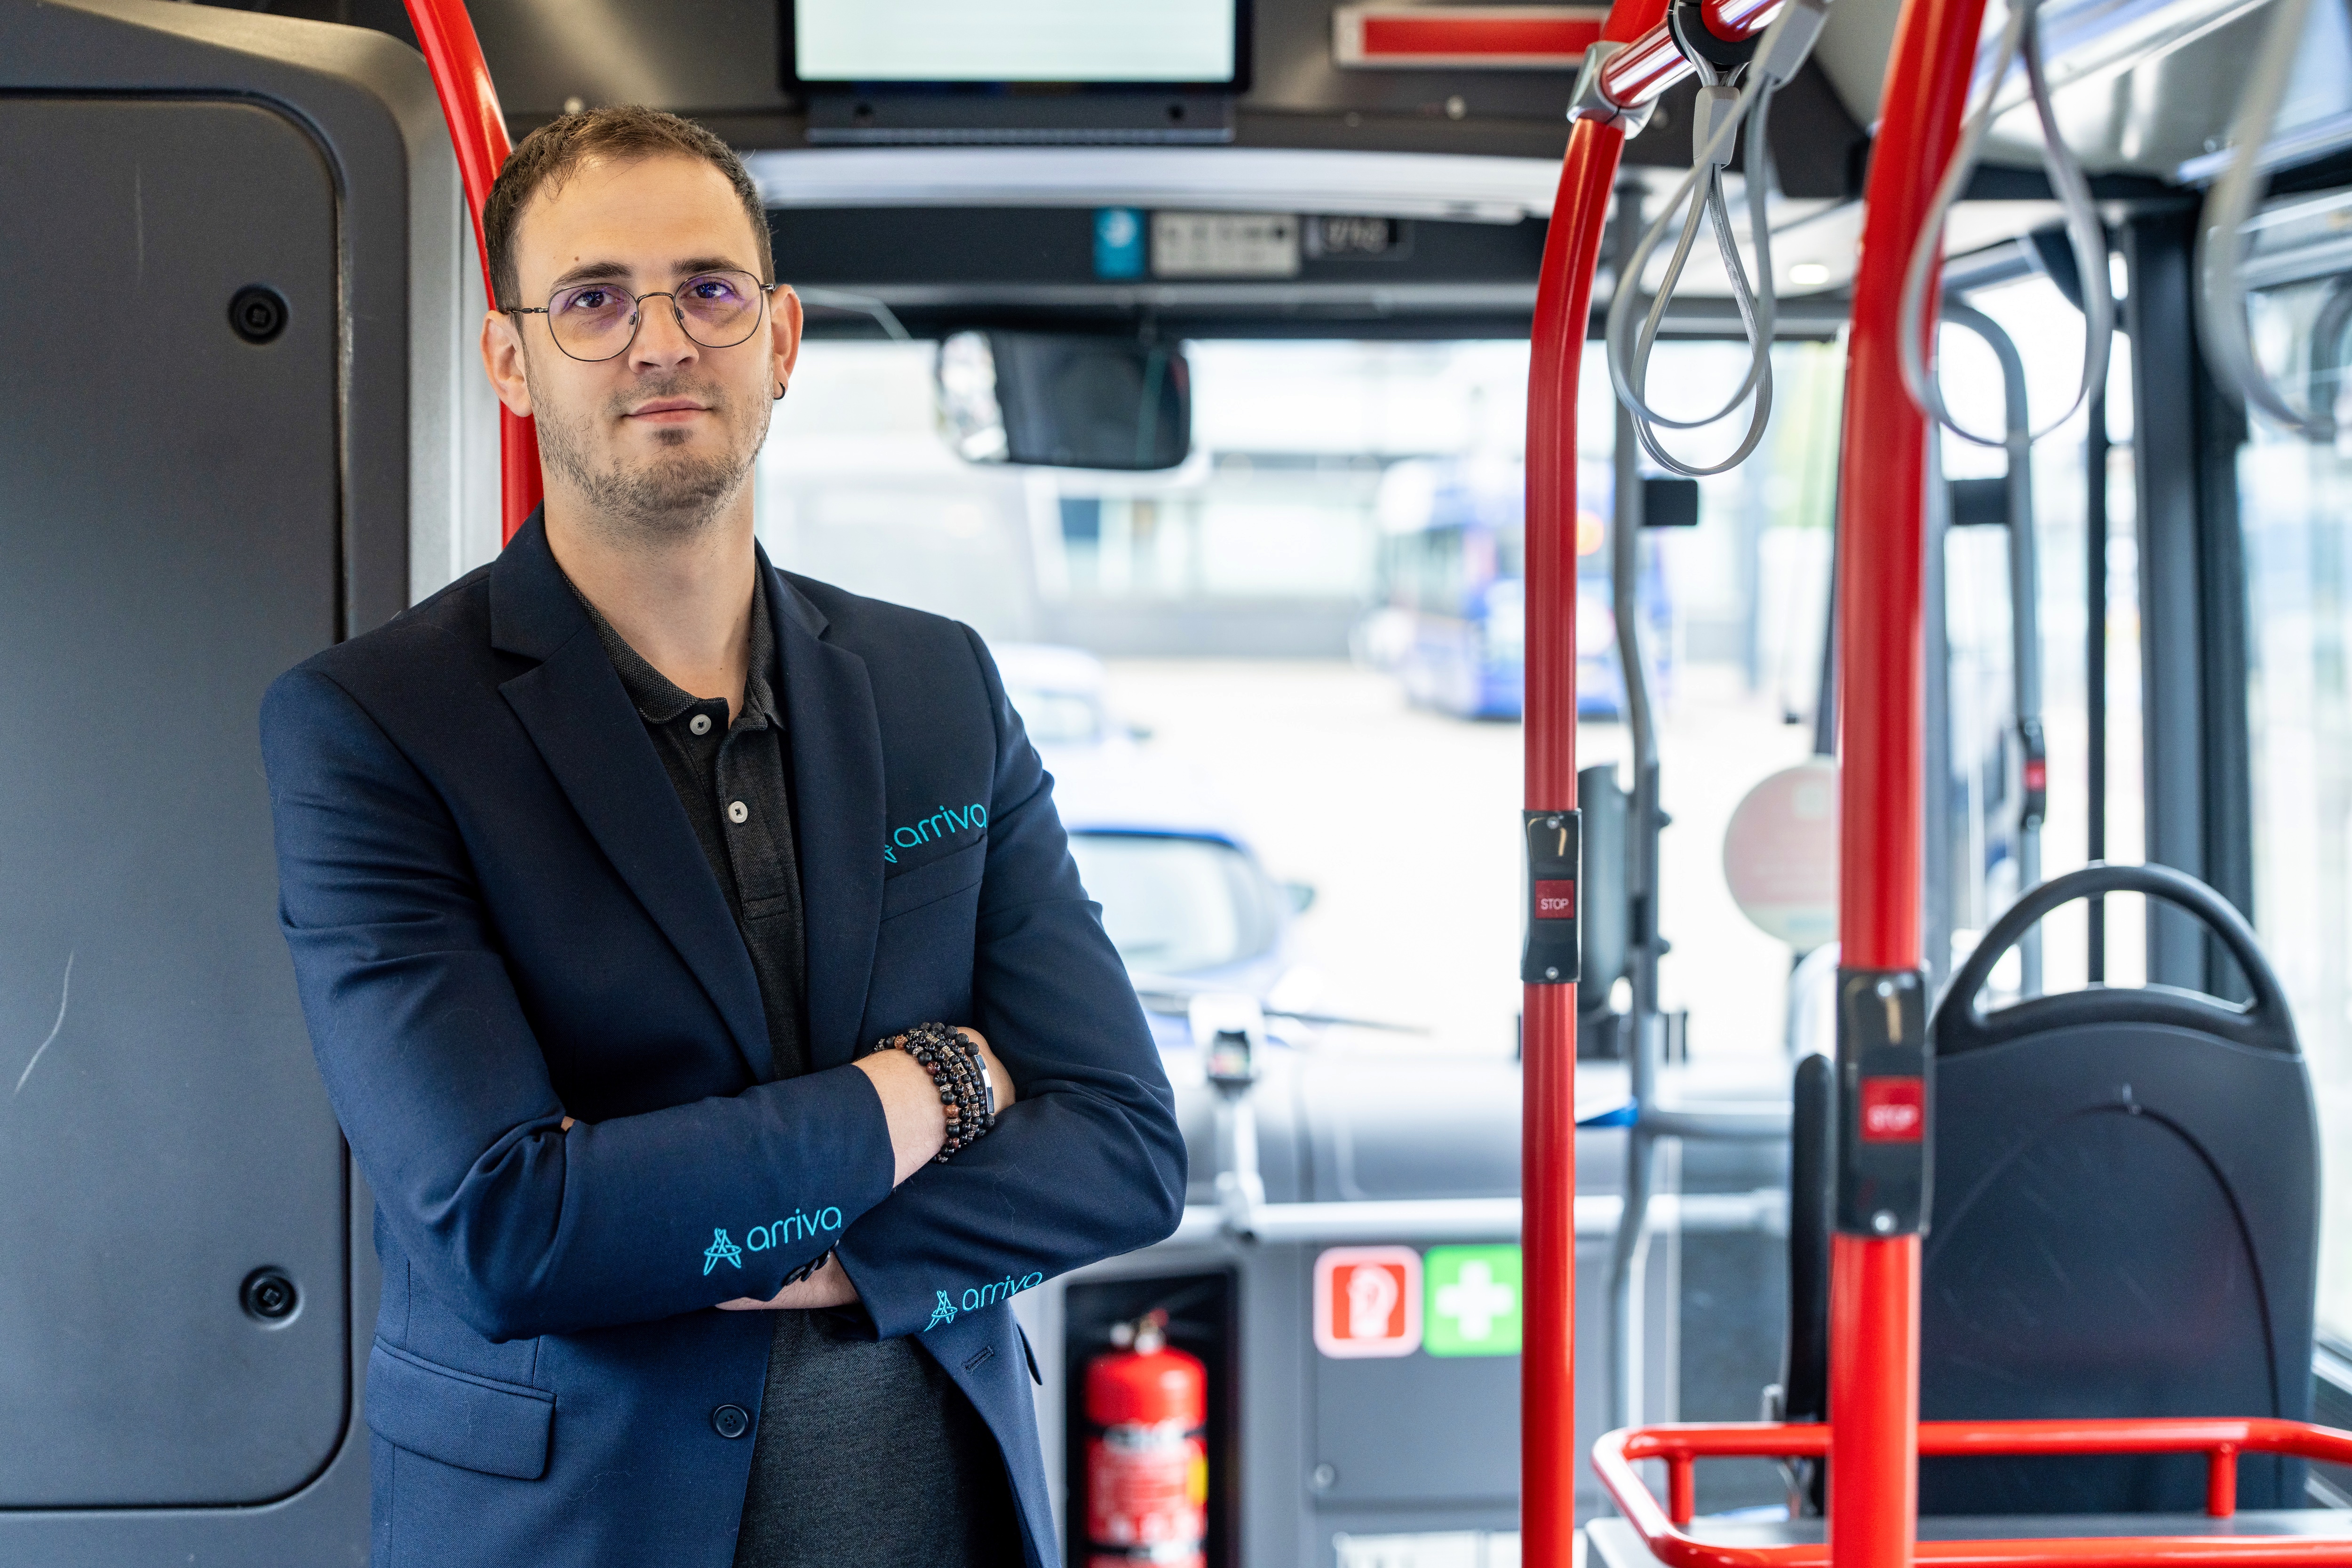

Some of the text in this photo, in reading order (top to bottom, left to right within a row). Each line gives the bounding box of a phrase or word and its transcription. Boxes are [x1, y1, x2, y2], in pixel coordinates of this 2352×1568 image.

[894, 803, 987, 847] arriva
[1540, 898, 1569, 910] STOP
[747, 1206, 842, 1252] arriva
